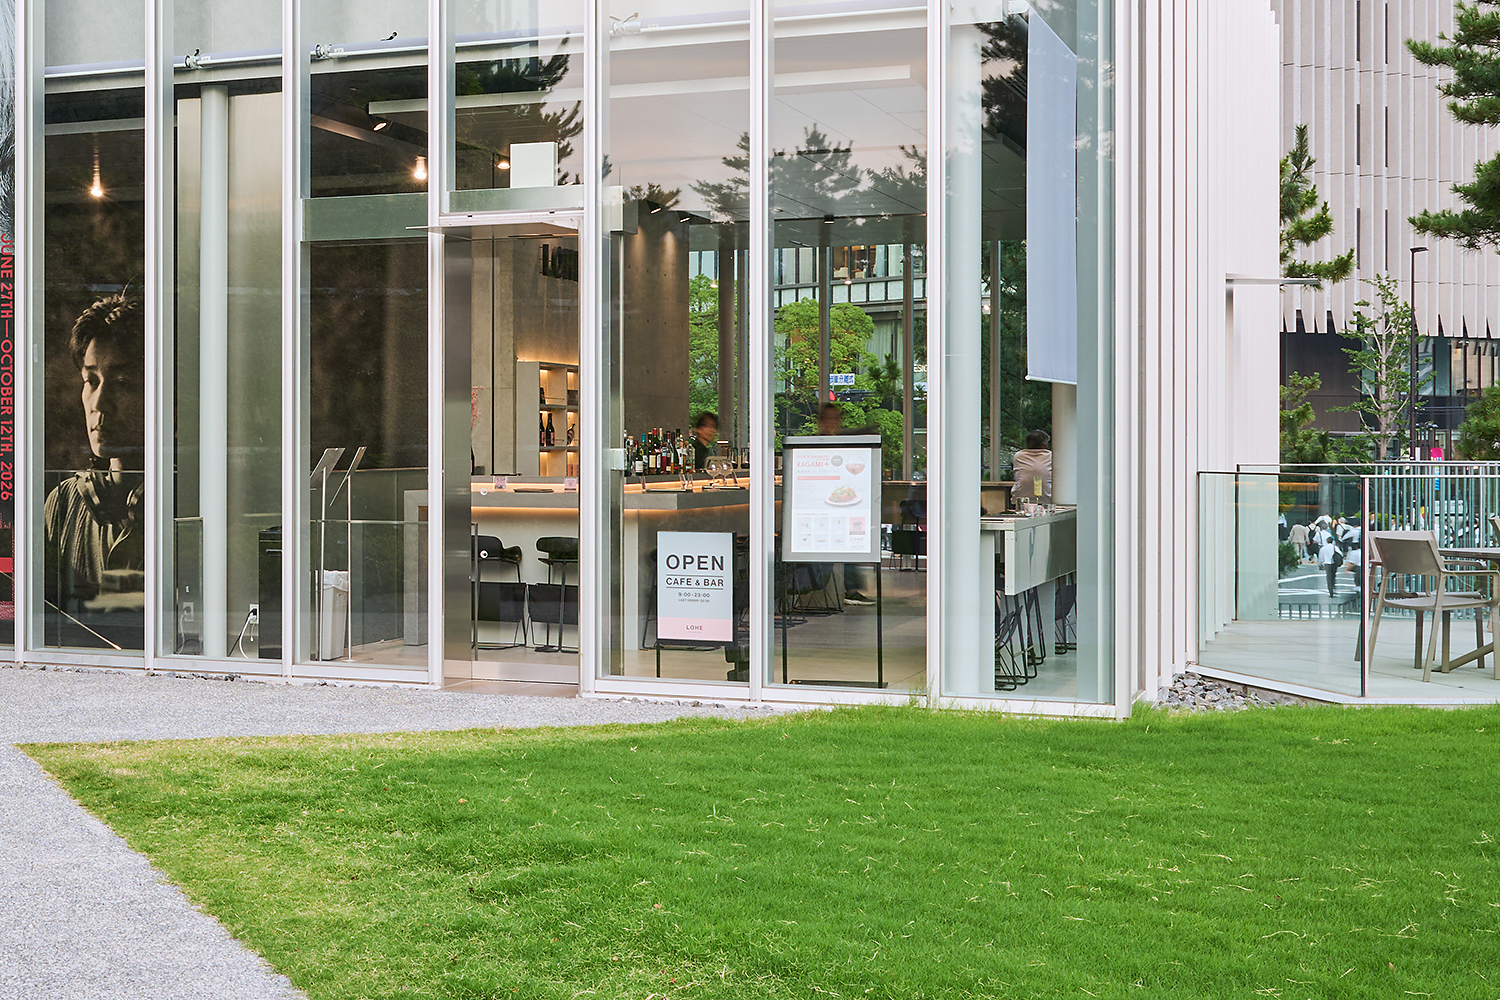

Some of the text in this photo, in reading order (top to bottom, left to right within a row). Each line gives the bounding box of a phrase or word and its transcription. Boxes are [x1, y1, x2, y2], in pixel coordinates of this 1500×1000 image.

[0, 232, 13, 279] JUNE
[0, 419, 13, 457] 12TH,
[0, 461, 13, 500] 2026
[666, 554, 724, 571] OPEN
[666, 577, 724, 587] CAFE & BAR
